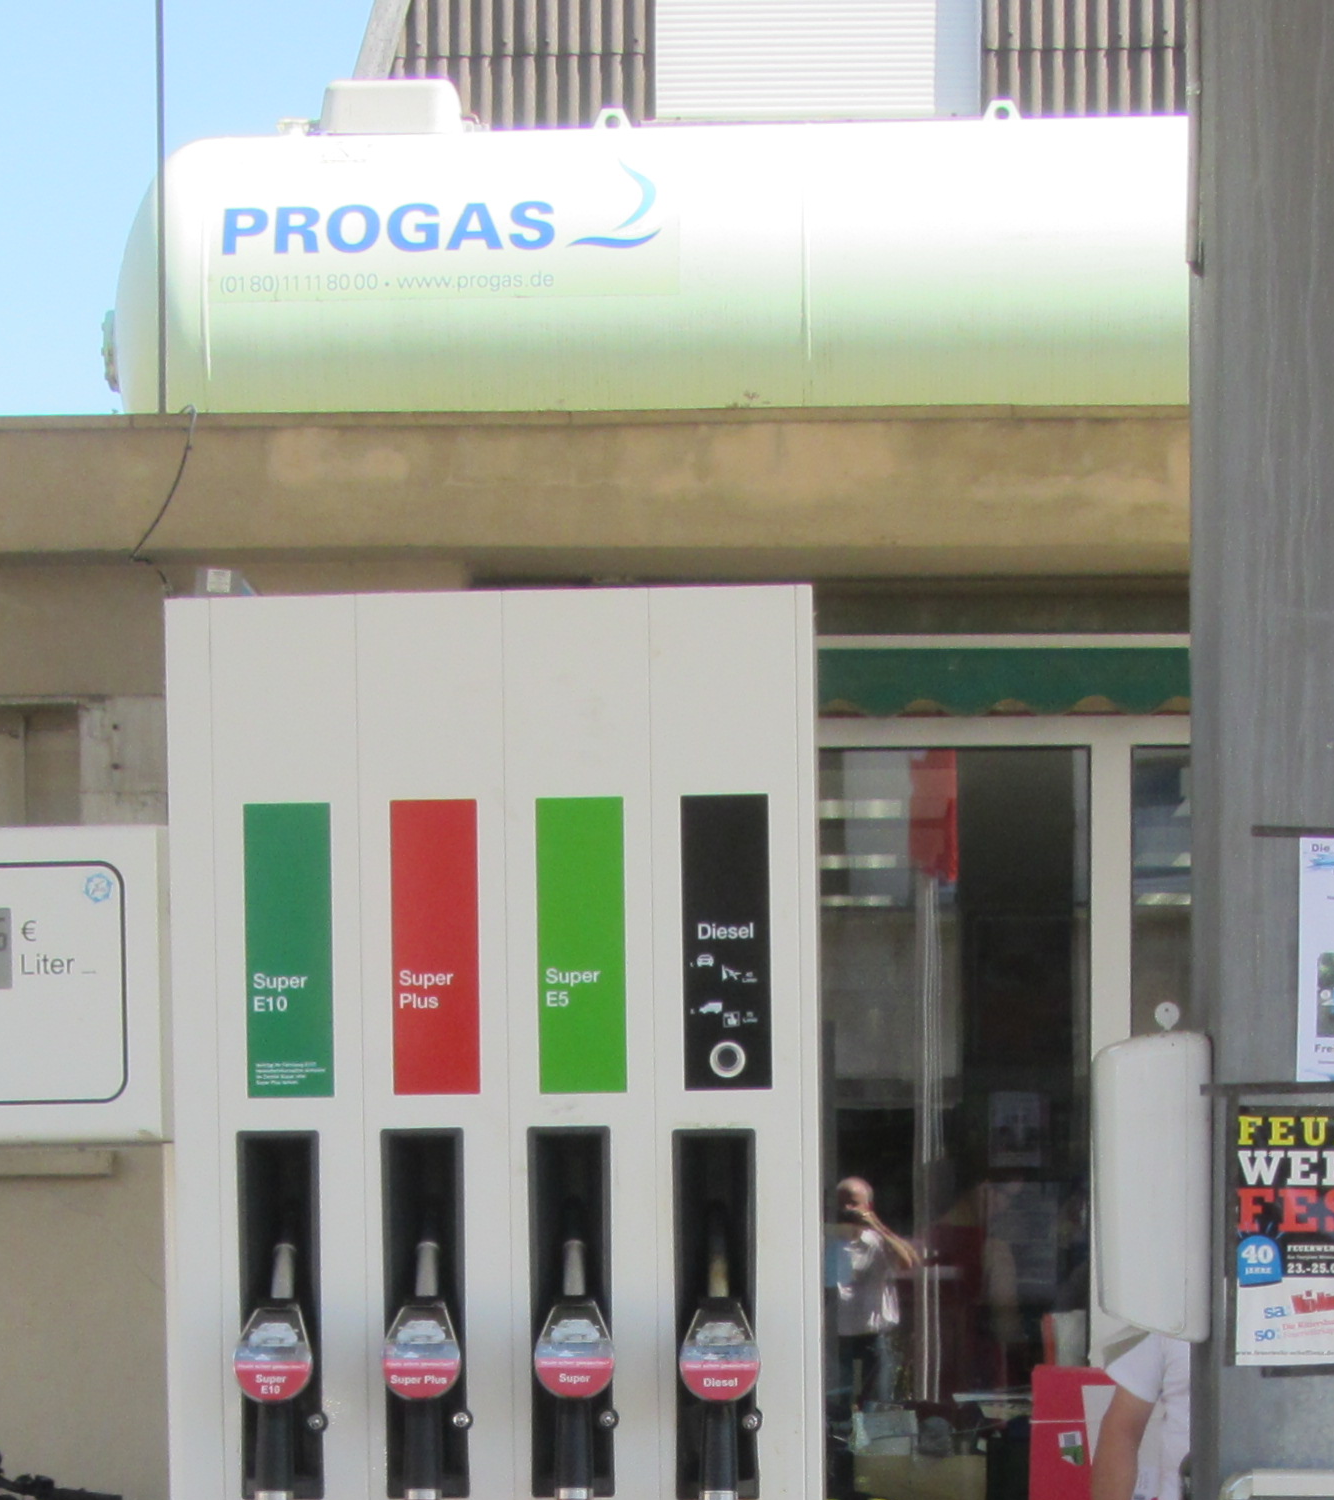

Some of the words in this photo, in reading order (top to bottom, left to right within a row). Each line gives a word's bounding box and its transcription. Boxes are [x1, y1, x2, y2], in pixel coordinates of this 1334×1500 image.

[221, 201, 555, 255] PROGAS
[397, 271, 554, 291] www.progas.de
[1311, 843, 1330, 852] Die
[21, 920, 37, 942] €
[697, 922, 754, 940] Diesel
[21, 954, 76, 976] Liter
[253, 973, 308, 992] Super
[399, 970, 454, 989] Super
[545, 967, 601, 986] Super
[253, 995, 288, 1013] E10
[399, 993, 439, 1010] Plus
[545, 991, 570, 1008] E5
[1241, 1245, 1274, 1263] 40
[255, 1374, 286, 1385] Super
[390, 1375, 421, 1386] Super
[424, 1375, 448, 1385] Plus
[559, 1373, 592, 1384] Super
[703, 1377, 738, 1387] Diesel
[260, 1386, 280, 1395] E10
